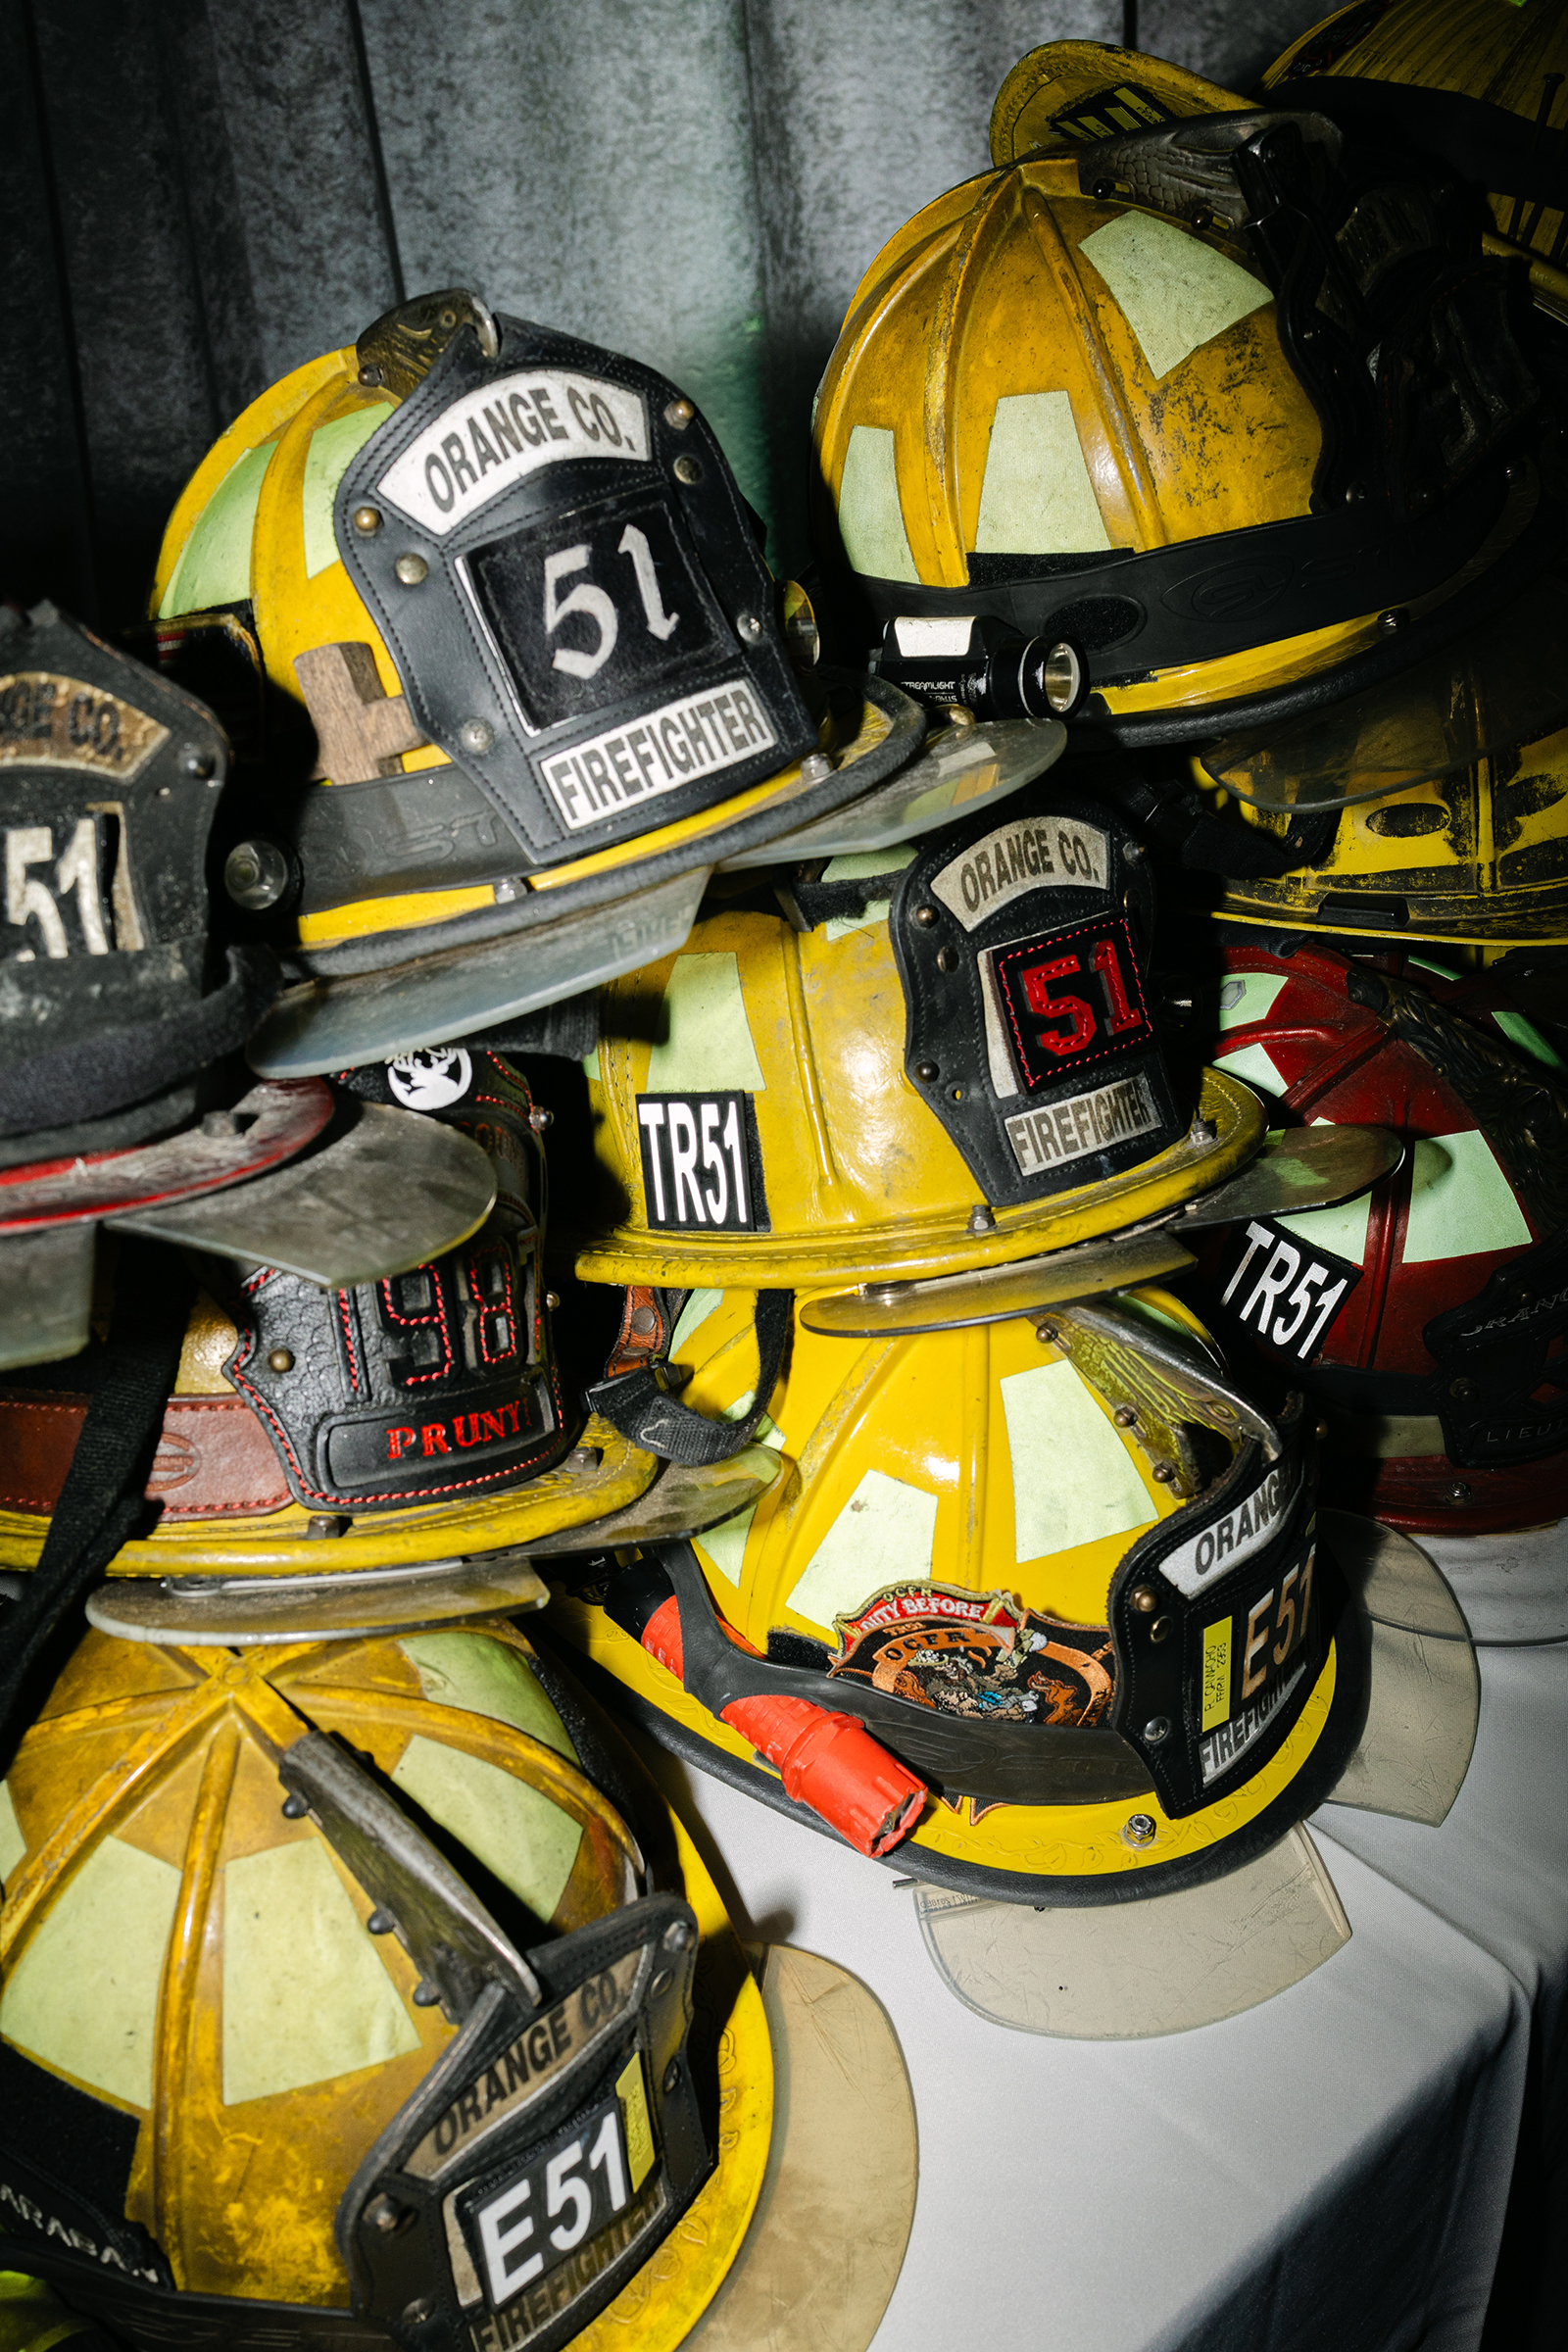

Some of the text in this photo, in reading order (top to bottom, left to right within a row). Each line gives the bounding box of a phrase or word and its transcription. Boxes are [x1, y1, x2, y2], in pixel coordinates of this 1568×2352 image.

[423, 386, 637, 514] ORANGE CO.
[543, 523, 680, 679] 51
[549, 689, 769, 820] FIREFIGHTER
[5, 817, 110, 962] 51
[959, 829, 1101, 913] ORANGE CO.
[1020, 938, 1143, 1056] 51
[637, 1100, 748, 1225] TR51
[1007, 1078, 1153, 1169] FIREFIGHTER
[376, 1237, 525, 1390] 98
[1220, 1220, 1348, 1360] TR51
[884, 1631, 971, 1661] OCFR
[901, 1596, 984, 1619] BEFORE
[1204, 1644, 1217, 1697] CAMACHO
[432, 2004, 572, 2156] ORANGE
[475, 2180, 662, 2352] FIREFIGHTER
[477, 2111, 627, 2305] E51
